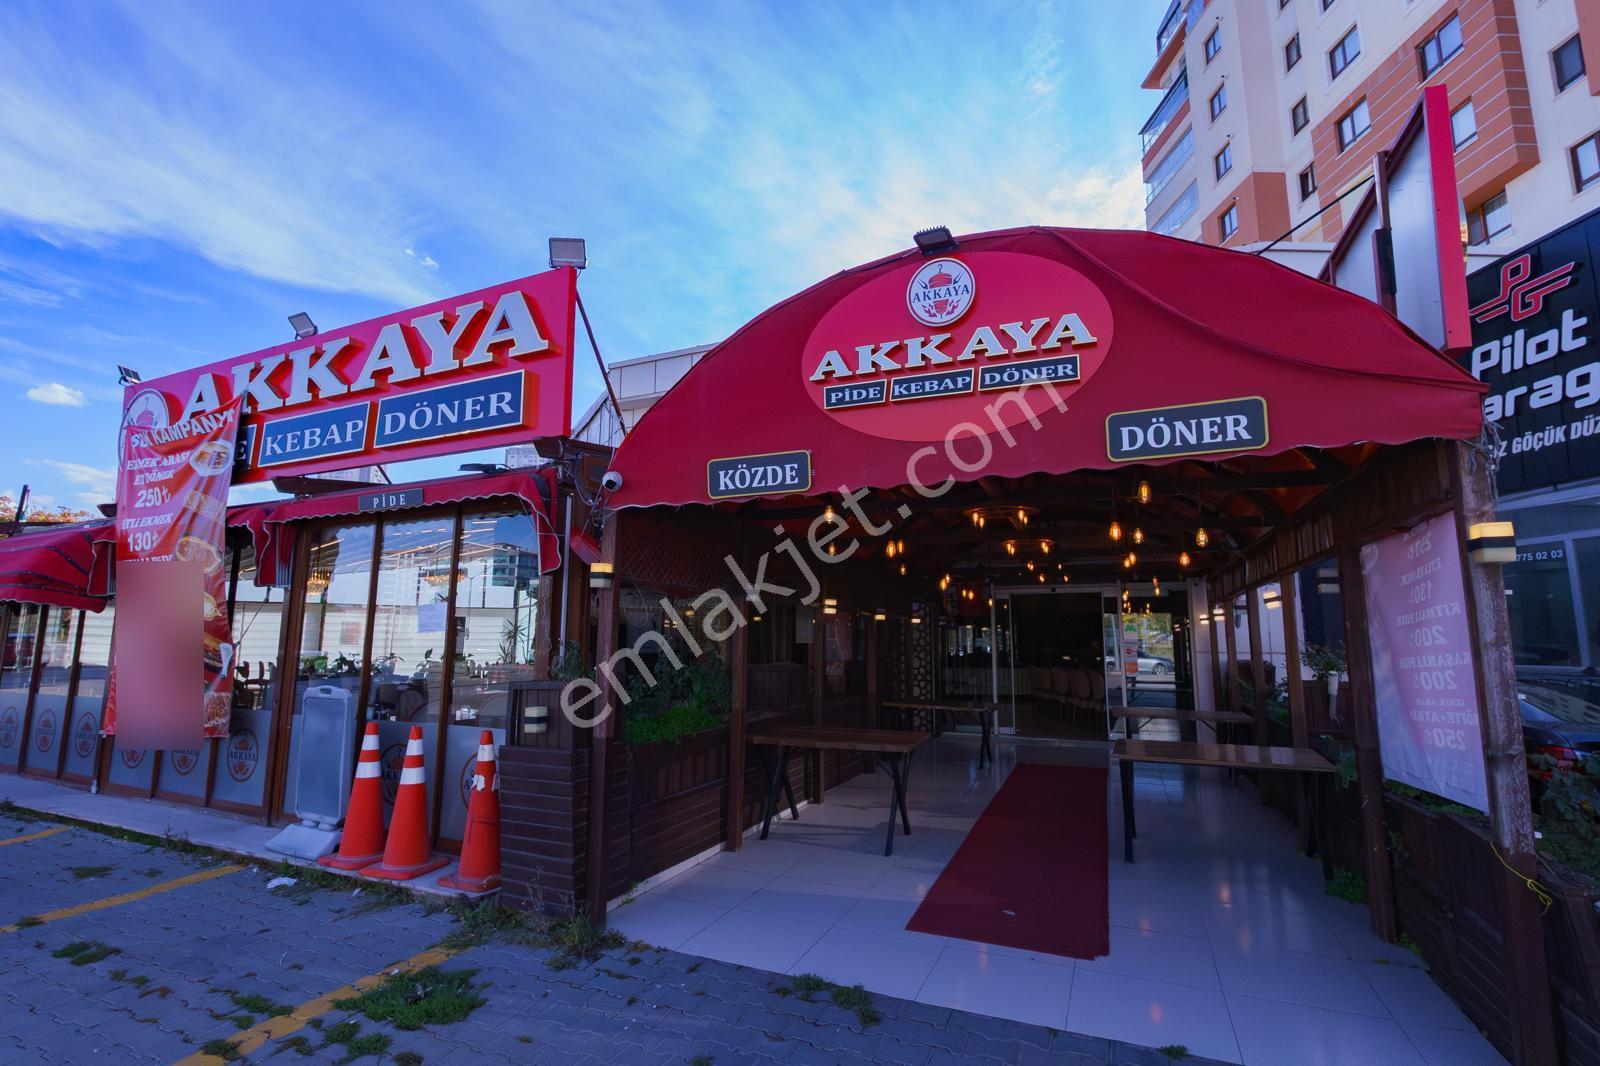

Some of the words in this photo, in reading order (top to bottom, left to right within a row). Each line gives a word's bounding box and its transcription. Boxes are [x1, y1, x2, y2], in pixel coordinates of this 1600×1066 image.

[912, 282, 971, 305] AKKAYA
[180, 290, 549, 418] AKKAYA
[809, 313, 1098, 382] AKKAYA
[1472, 308, 1588, 380] Pilot
[830, 384, 882, 404] PİDE
[892, 374, 971, 398] KEBAP
[983, 362, 1075, 385] DÖNER
[1484, 362, 1600, 422] arag
[264, 418, 366, 457] KEBAP
[384, 391, 514, 435] DÖNER
[1120, 413, 1253, 452] DÖNER
[1511, 424, 1567, 454] GÖÇÜK
[718, 463, 800, 491] KÖZDE
[373, 493, 407, 509] PİDE
[1536, 549, 1549, 561] 02
[1551, 549, 1564, 561] 03
